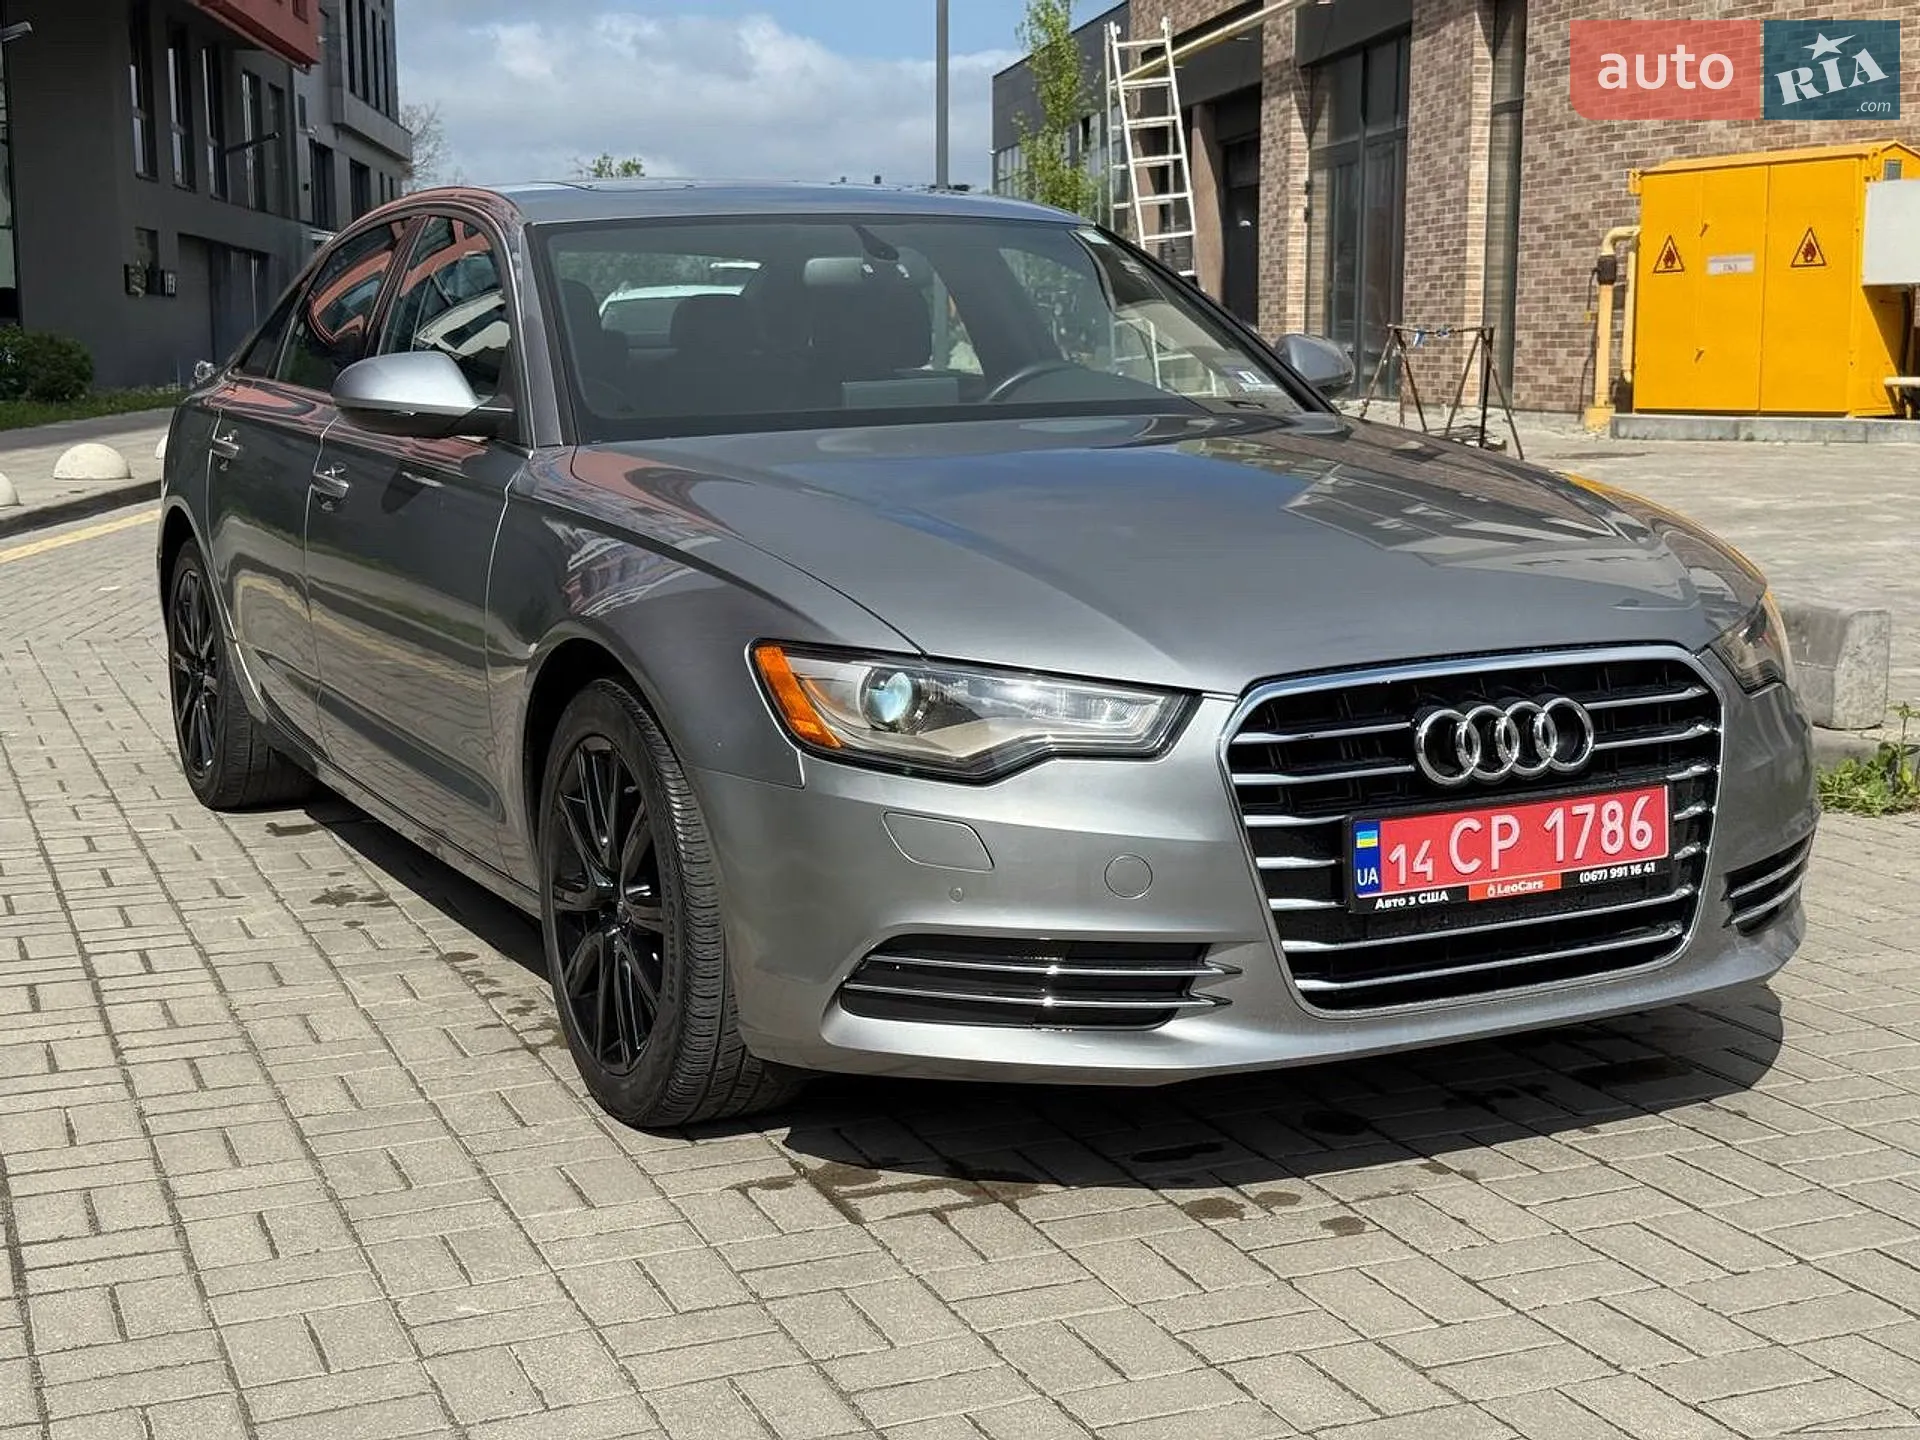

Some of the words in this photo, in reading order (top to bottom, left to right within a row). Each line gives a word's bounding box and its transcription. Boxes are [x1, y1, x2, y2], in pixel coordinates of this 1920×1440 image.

[1388, 843, 1435, 885] 14
[1448, 814, 1521, 874] CP
[1543, 795, 1653, 862] 1786
[1357, 867, 1379, 886] UA
[1579, 871, 1607, 884] (067)
[1609, 867, 1628, 879] 991
[1630, 864, 1642, 876] 16
[1644, 862, 1656, 874] 41
[1497, 880, 1544, 895] LeoCars
[1374, 897, 1406, 911] Авто
[1418, 891, 1449, 904] США
